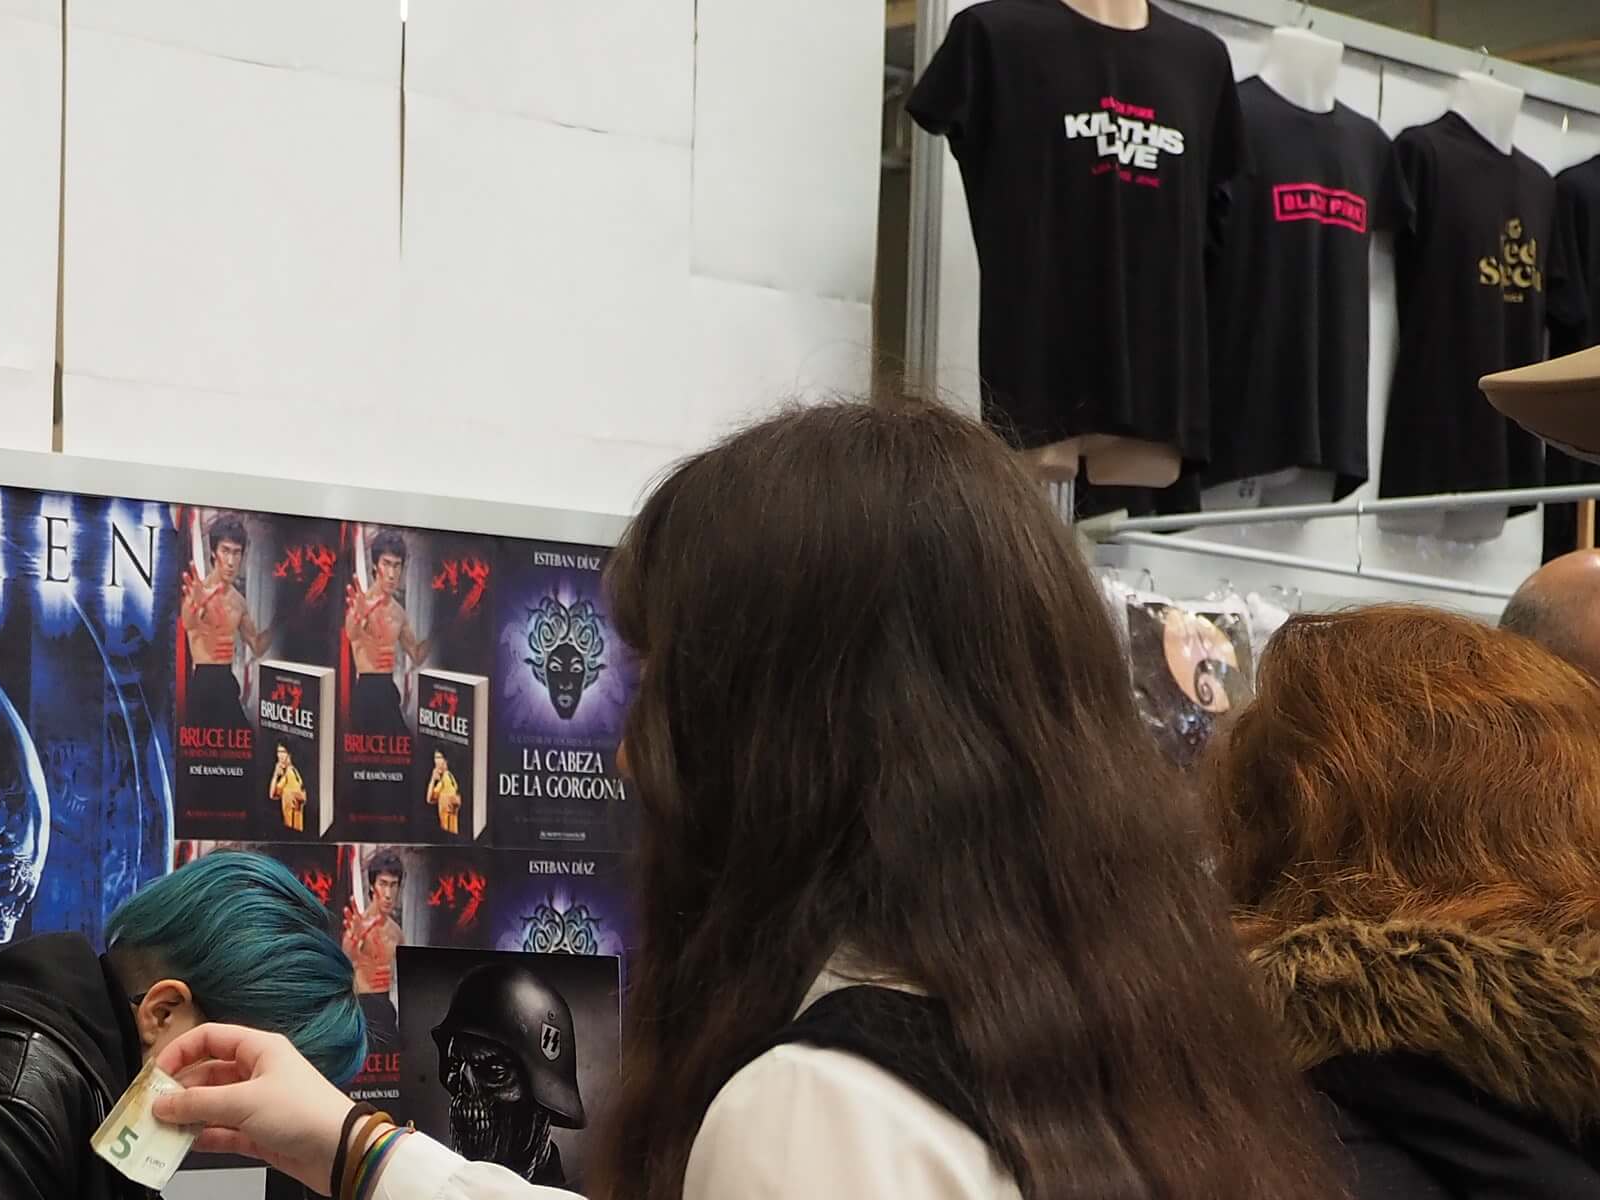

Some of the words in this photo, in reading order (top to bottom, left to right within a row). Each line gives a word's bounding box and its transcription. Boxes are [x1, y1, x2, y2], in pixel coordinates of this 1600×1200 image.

[533, 551, 576, 569] ESTEBAN
[577, 553, 600, 570] DÍAZ
[260, 699, 293, 723] BRUCE
[295, 708, 314, 729] LEE
[419, 707, 449, 729] BRUCE
[451, 716, 469, 736] LEE
[179, 727, 224, 748] BRUCE
[228, 730, 252, 748] LEE
[344, 734, 385, 753] BRUCE
[389, 737, 410, 753] LEE
[523, 749, 541, 772] LA
[545, 750, 603, 775] CABEZA
[499, 774, 520, 798] DE
[523, 775, 542, 799] LA
[546, 775, 626, 801] GORGONA
[529, 859, 570, 875] ESTEBAN
[571, 861, 595, 877] DÍAZ
[110, 1124, 139, 1160] 5
